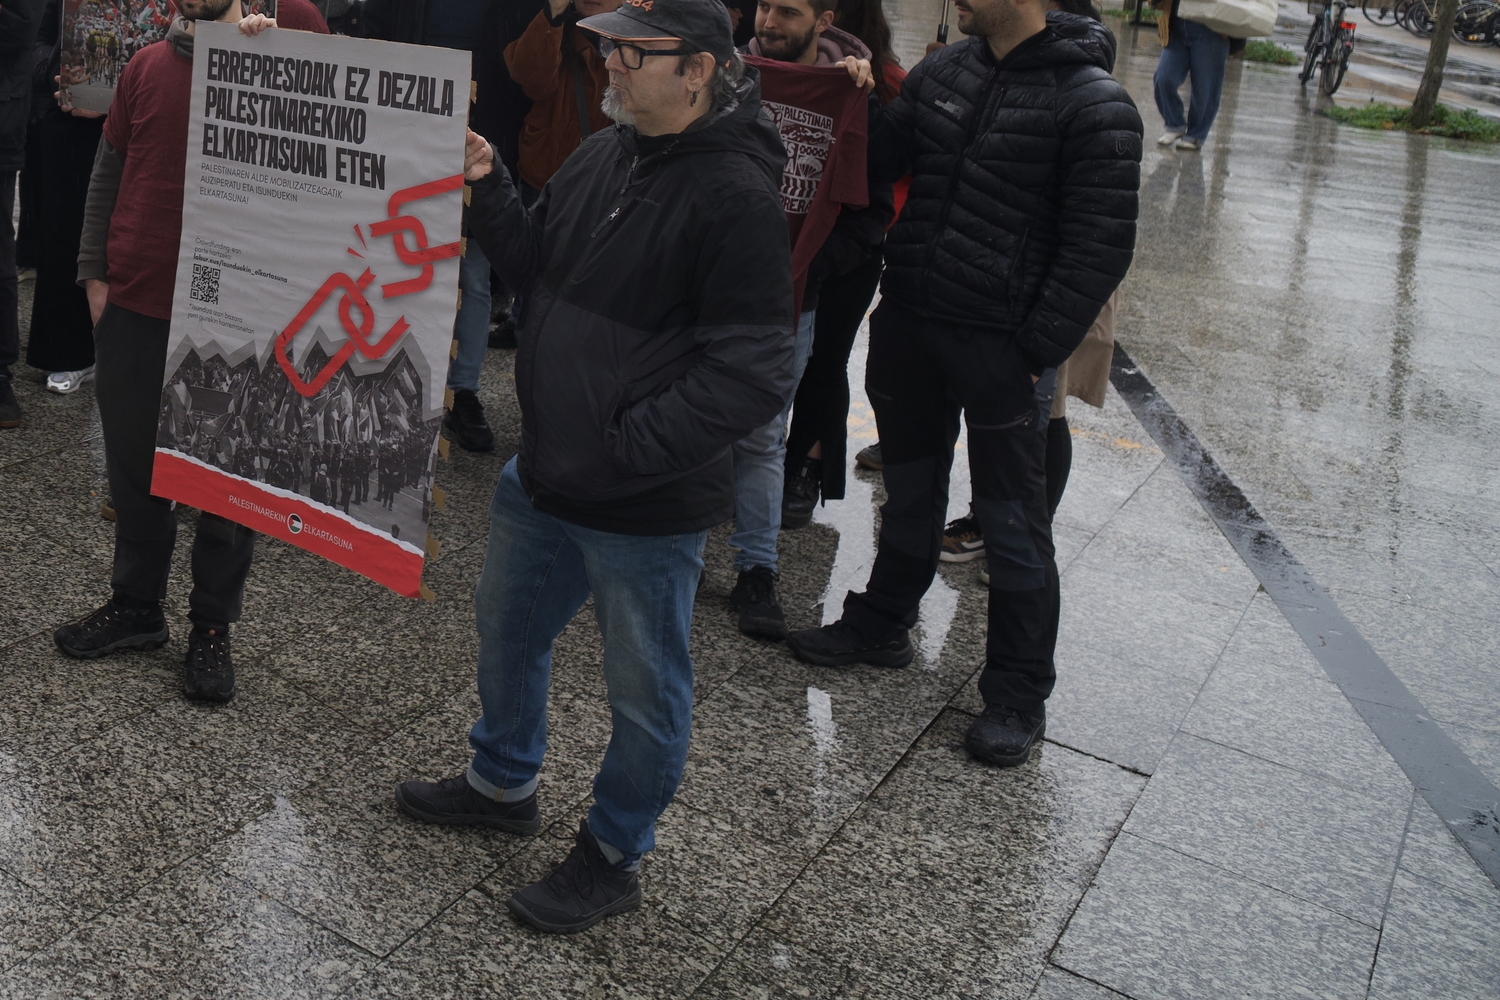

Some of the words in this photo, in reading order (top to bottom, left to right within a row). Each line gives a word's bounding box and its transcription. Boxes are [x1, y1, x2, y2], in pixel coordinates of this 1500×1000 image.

[207, 47, 338, 99] ERREPRESIOAK
[344, 65, 371, 104] EZ
[377, 70, 454, 117] DEZALA
[204, 85, 367, 145] PALESTINAREKIKO
[784, 106, 832, 130] PALESTINAR
[202, 123, 327, 179] ELKARTASUNA
[335, 145, 386, 190] ETEN
[199, 187, 249, 204] ELKARTASUNA!
[200, 175, 241, 190] AUZIPERATU
[242, 183, 254, 194] ETA
[255, 187, 298, 203] ISUNDUEKIN
[201, 163, 250, 179] PALESTINAREN
[251, 173, 269, 184] ALDE
[269, 177, 343, 199] MOBILIZATZEAGATIK
[228, 494, 286, 524] PALESTINAREKIN
[303, 524, 354, 552] ELKARTASUNA
